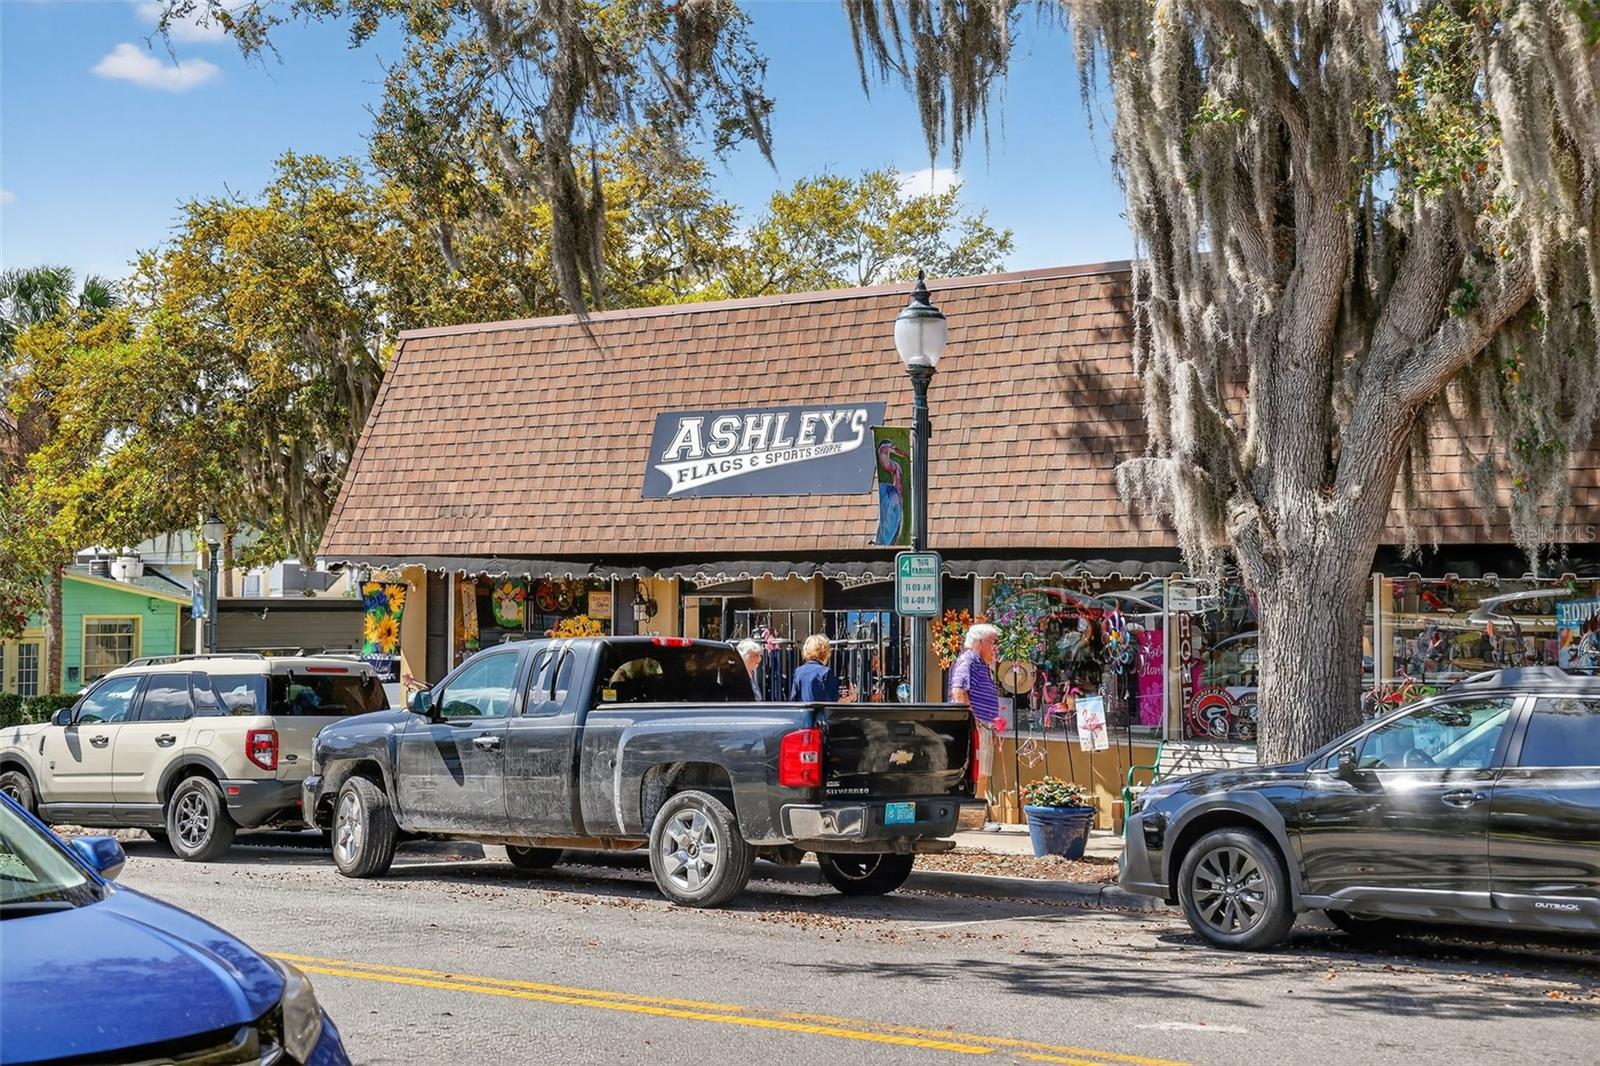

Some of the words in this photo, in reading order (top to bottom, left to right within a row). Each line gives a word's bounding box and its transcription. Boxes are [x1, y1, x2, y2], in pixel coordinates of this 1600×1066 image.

[661, 409, 868, 462] ASHLEY'S
[677, 458, 743, 484] FLAGS
[765, 447, 812, 464] SPORTS
[902, 560, 910, 574] 4
[1535, 902, 1579, 910] OUTBACK
